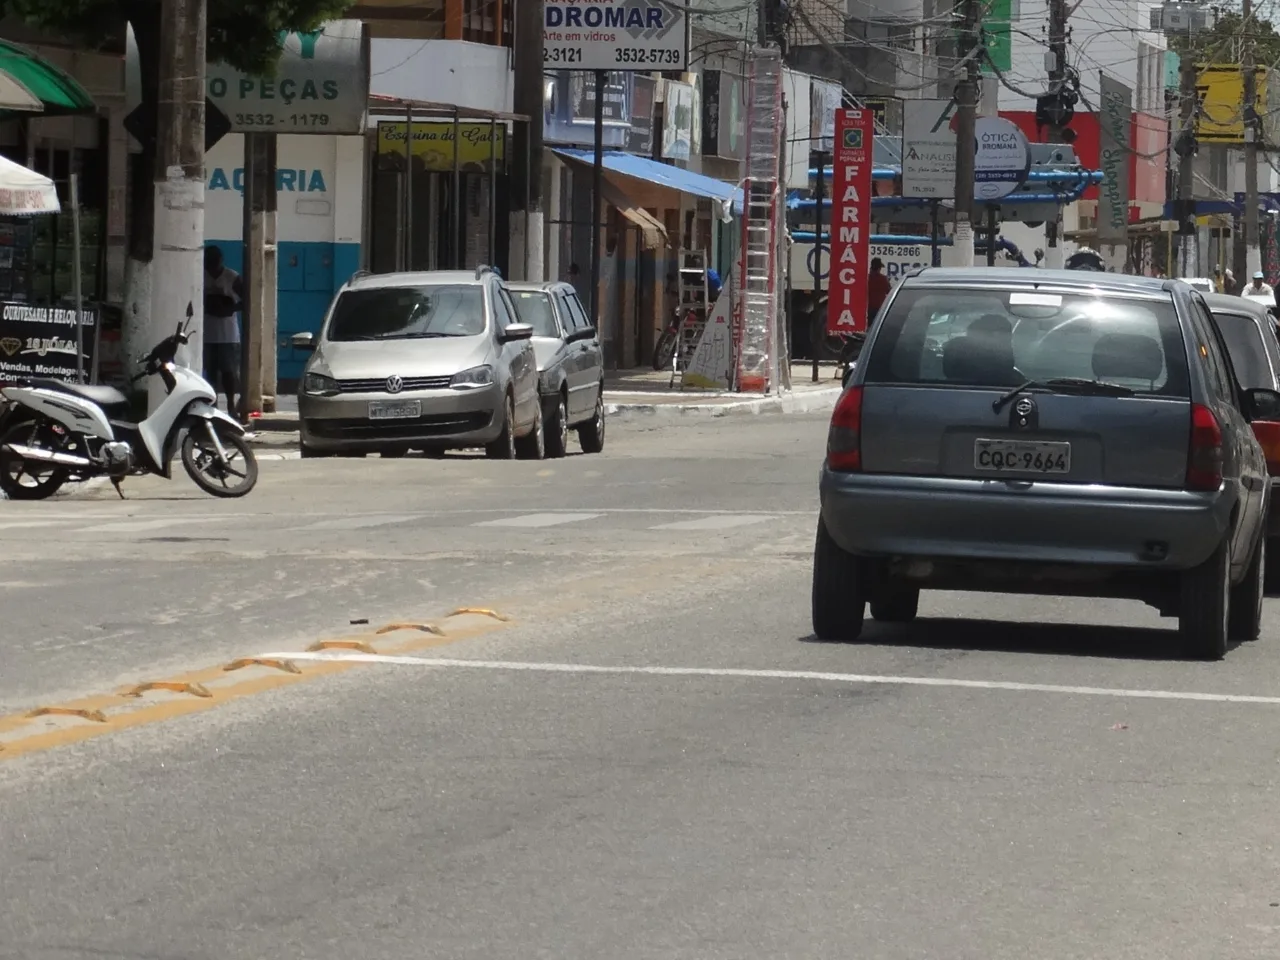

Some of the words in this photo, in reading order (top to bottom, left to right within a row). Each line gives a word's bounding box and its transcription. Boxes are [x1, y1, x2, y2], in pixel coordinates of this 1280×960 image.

[546, 6, 664, 29] DROMAR
[566, 33, 580, 41] em
[584, 31, 616, 42] vidros
[615, 48, 680, 64] 3532-5739
[239, 78, 339, 105] PEÇAS
[236, 113, 275, 126] 3532
[290, 113, 330, 126] 1179
[981, 132, 1017, 143] ÓTICA
[1102, 149, 1127, 229] Shopping
[837, 165, 860, 326] FARMÁCIA
[871, 246, 921, 256] 3526-2866
[48, 308, 54, 323] E
